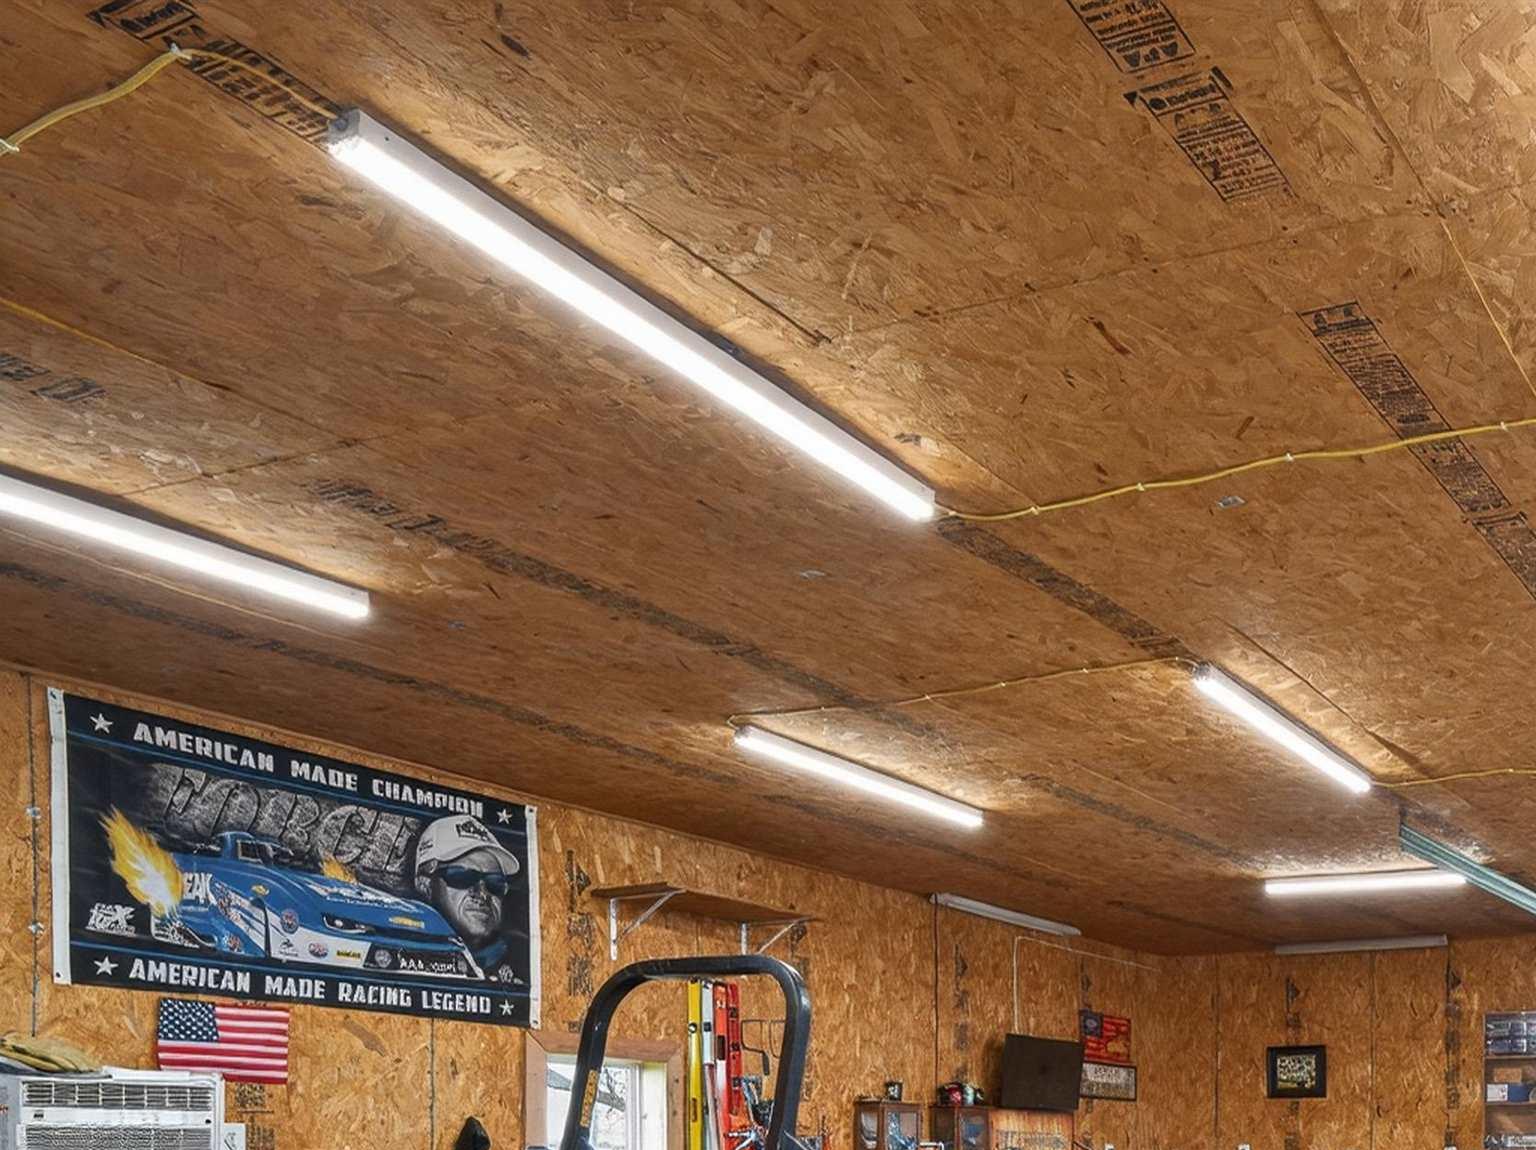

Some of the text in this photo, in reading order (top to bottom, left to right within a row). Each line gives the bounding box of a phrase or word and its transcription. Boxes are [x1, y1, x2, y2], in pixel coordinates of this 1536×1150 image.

[133, 722, 484, 819] AMERICAN MADE CHAMPION
[129, 957, 492, 1015] AMERICAN MADE RACING LEGEND
